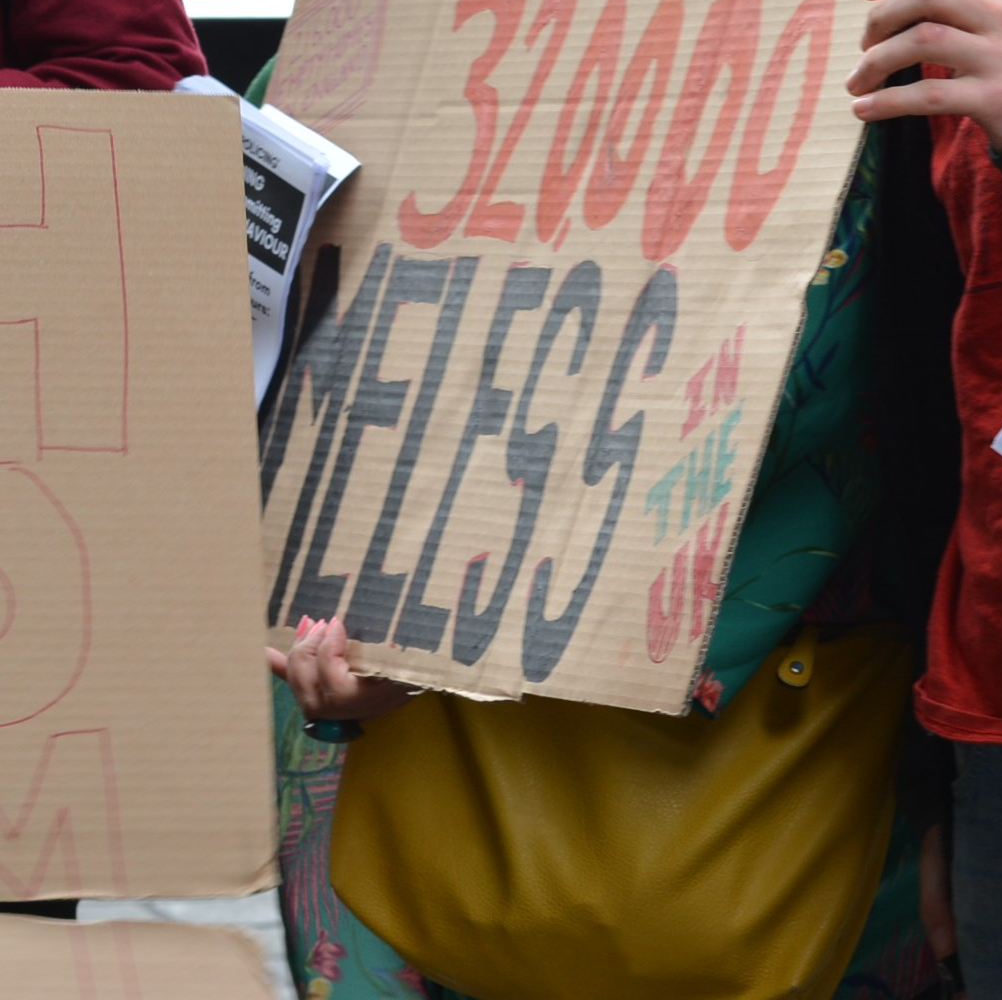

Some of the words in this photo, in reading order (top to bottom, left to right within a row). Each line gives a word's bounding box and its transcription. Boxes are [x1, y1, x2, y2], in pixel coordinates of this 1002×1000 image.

[680, 321, 748, 442] IN
[258, 241, 678, 683] MELESS
[643, 398, 746, 547] THE
[645, 501, 730, 664] UK
